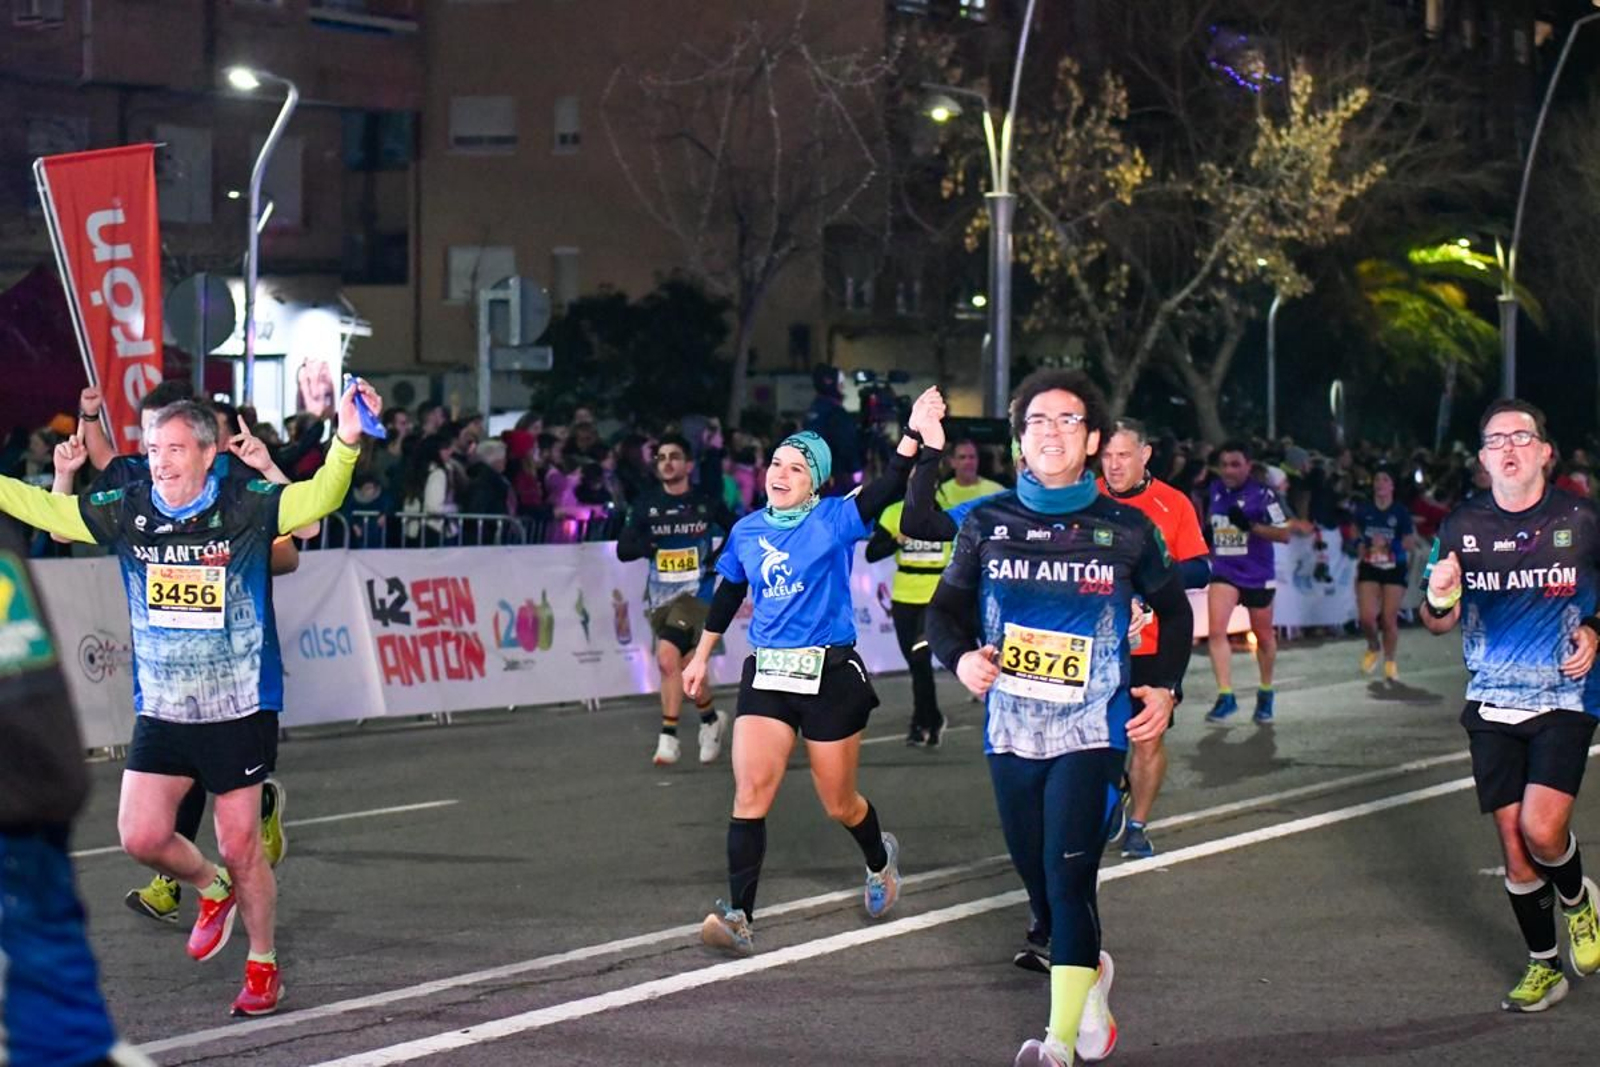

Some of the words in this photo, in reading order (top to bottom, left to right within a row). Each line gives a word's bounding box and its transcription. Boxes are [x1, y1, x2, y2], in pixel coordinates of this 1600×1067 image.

[164, 540, 230, 563] ANTÓN
[660, 557, 695, 571] 4148
[987, 559, 1029, 580] SAN
[1035, 559, 1114, 585] ANTÓN
[1465, 571, 1500, 591] SAN
[1506, 562, 1577, 590] ANTÓN
[152, 582, 217, 605] 3456
[366, 576, 412, 627] 42
[410, 576, 477, 629] SAN
[761, 582, 805, 598] GACELAS
[299, 622, 354, 660] alsa
[761, 650, 817, 675] 2339
[1005, 645, 1081, 679] 3976
